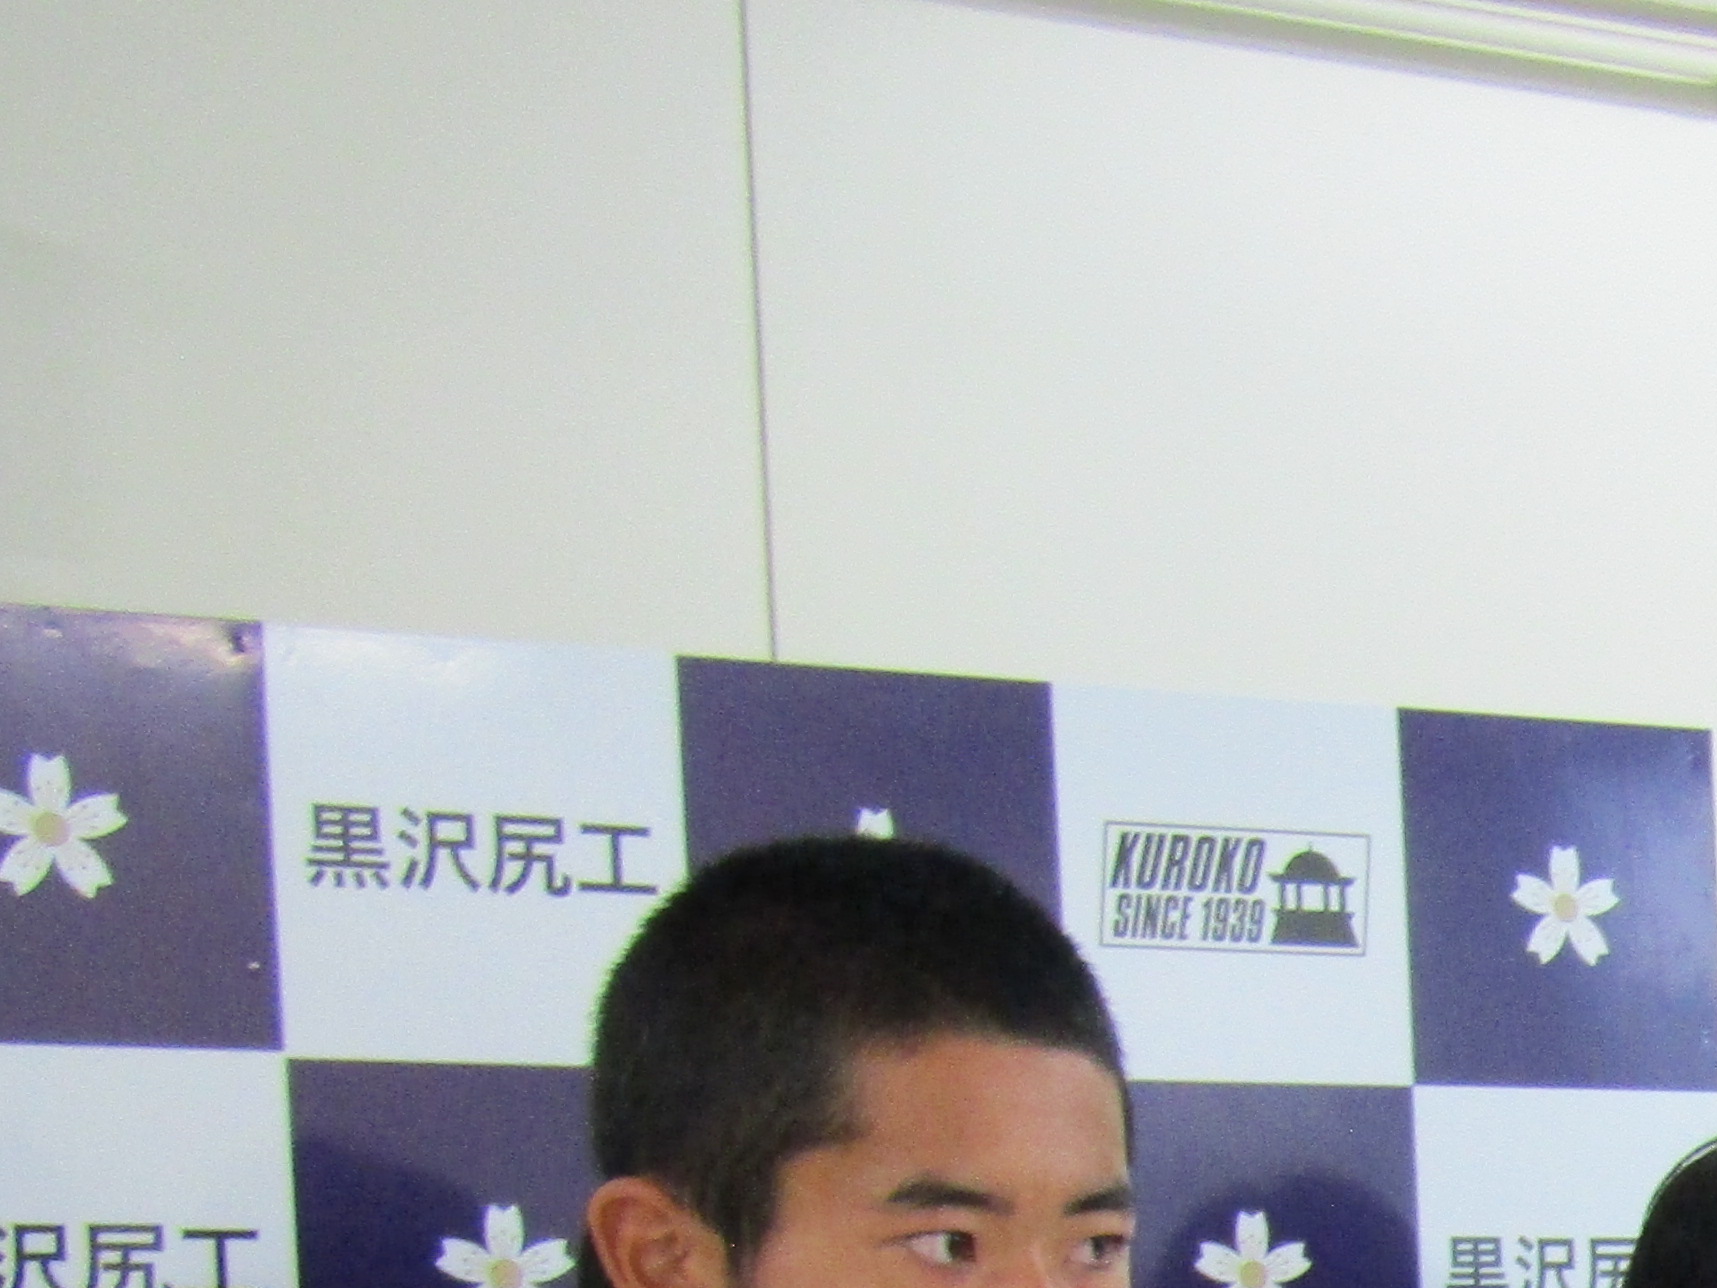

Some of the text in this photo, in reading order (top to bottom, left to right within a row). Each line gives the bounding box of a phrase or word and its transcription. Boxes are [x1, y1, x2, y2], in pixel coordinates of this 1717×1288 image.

[306, 801, 657, 896] 黒沢尻工
[1110, 832, 1266, 894] KUROKO
[1113, 893, 1265, 942] SINCE 1939
